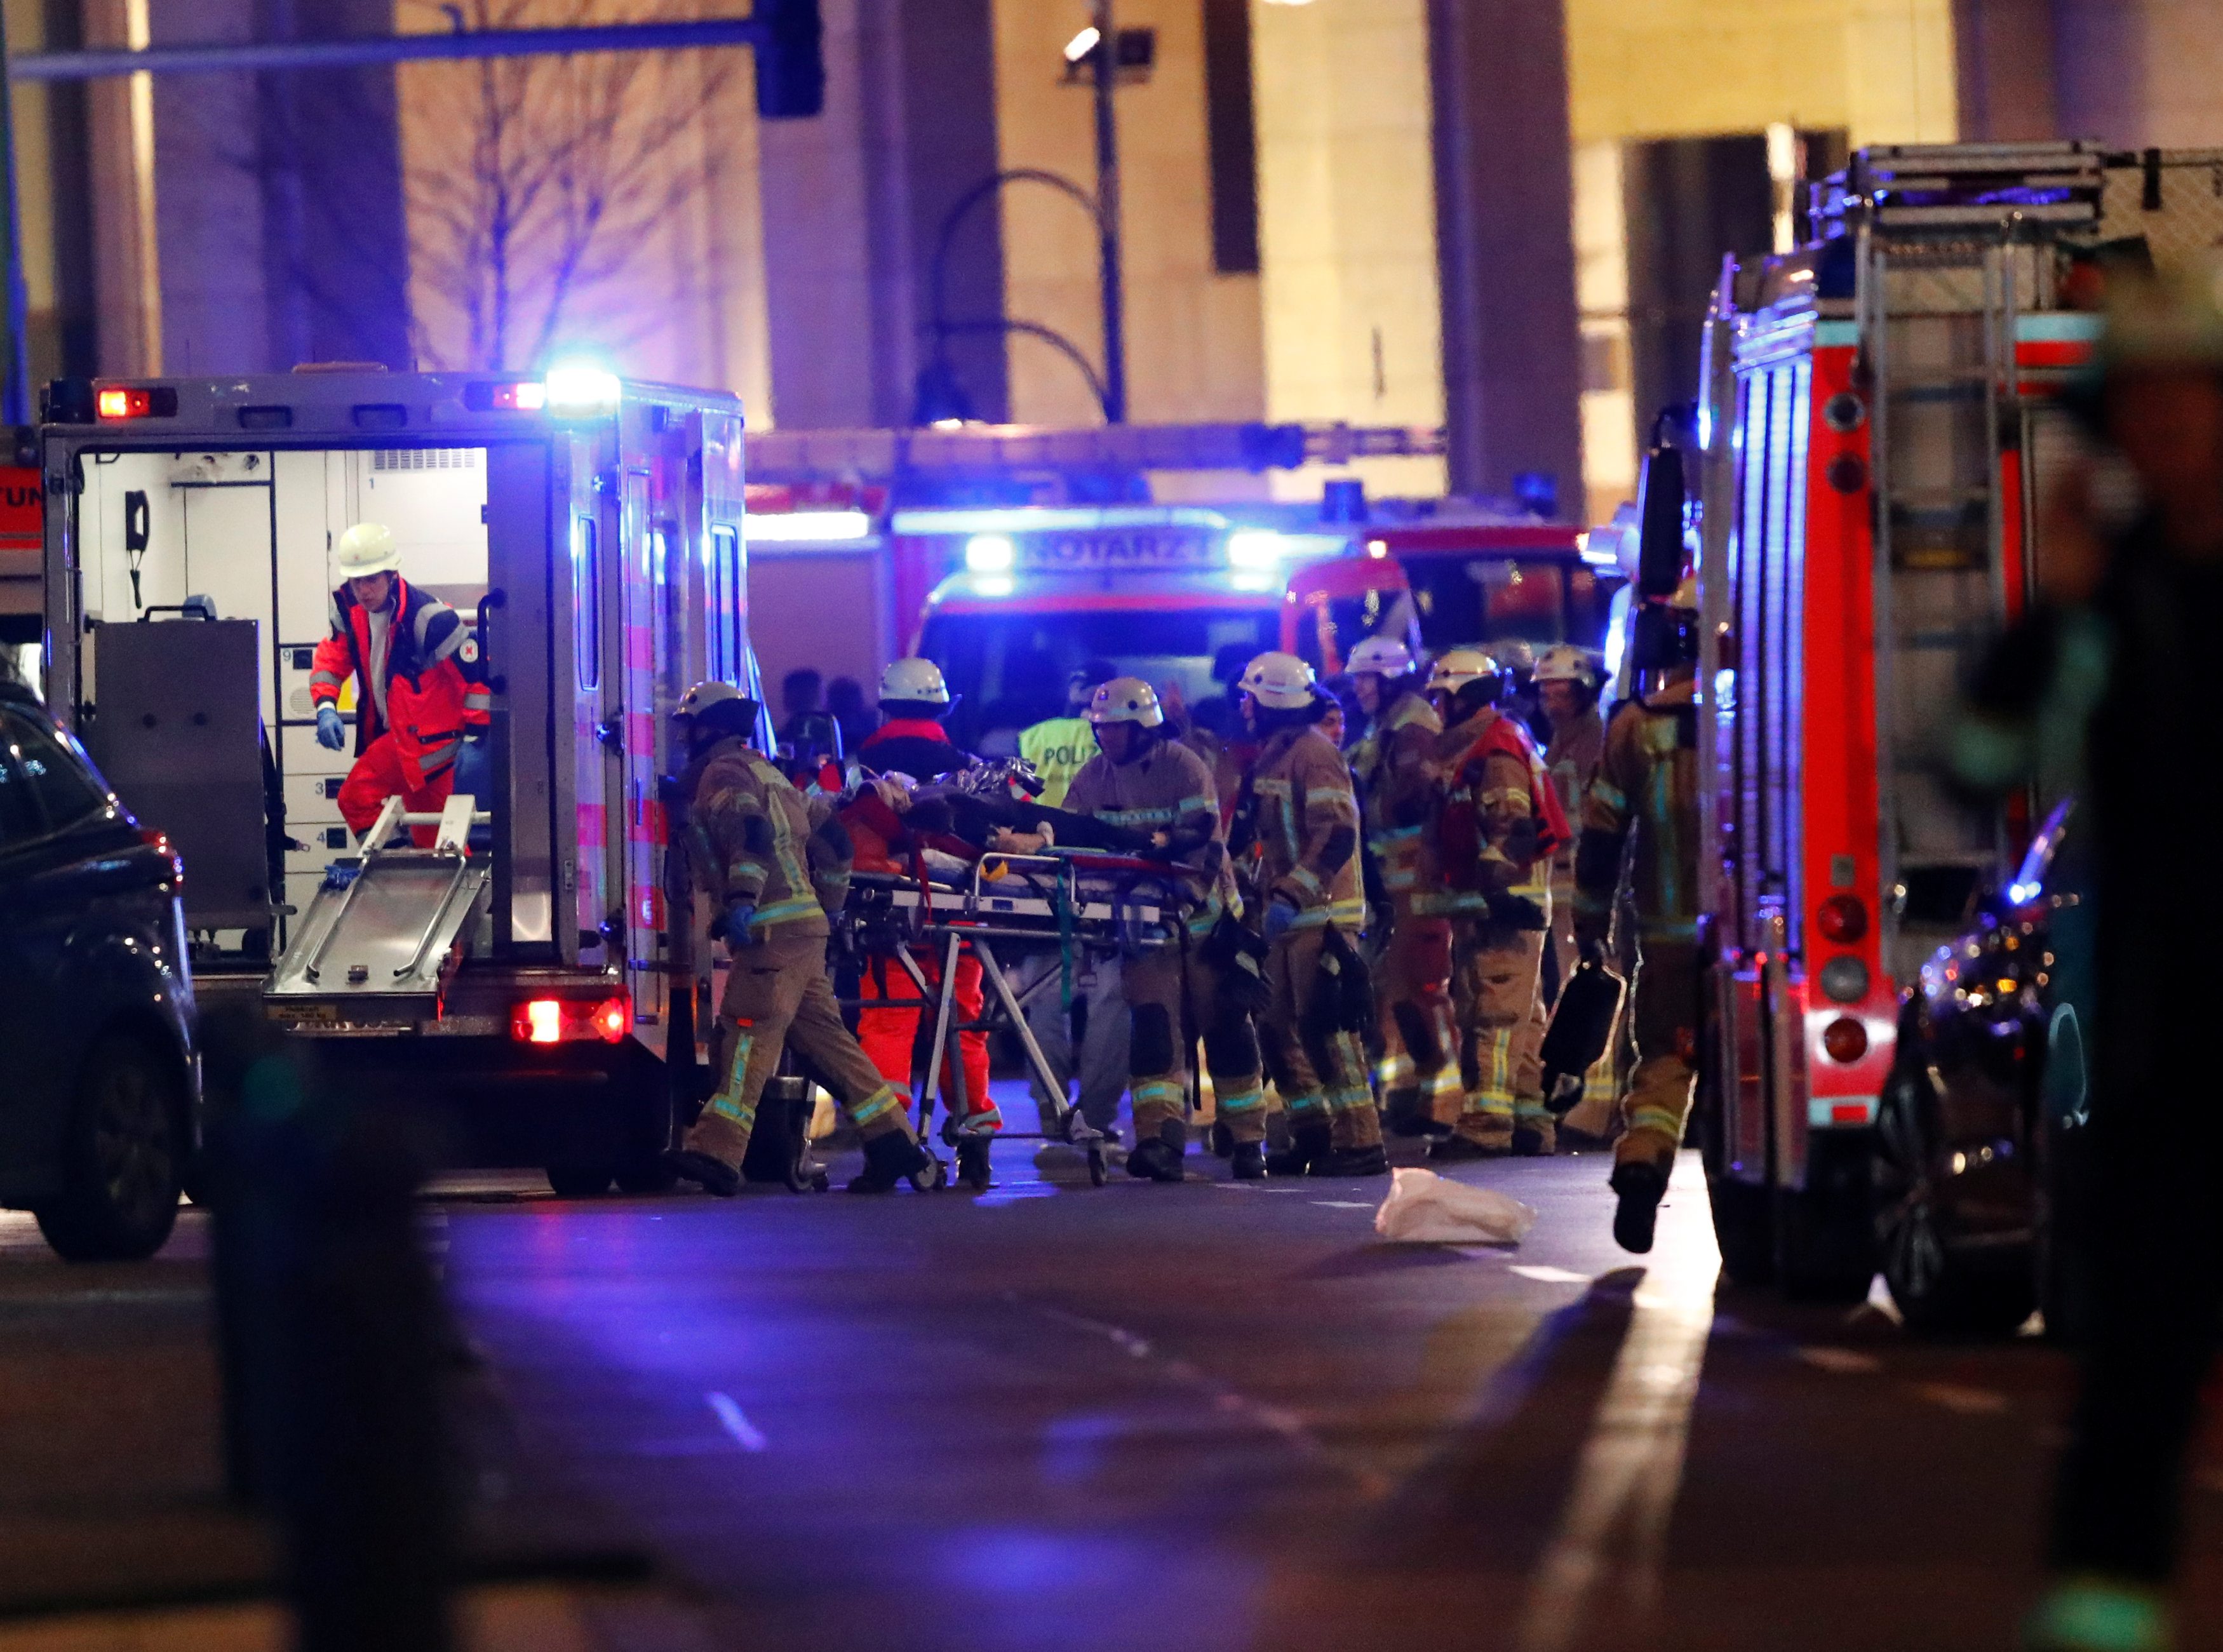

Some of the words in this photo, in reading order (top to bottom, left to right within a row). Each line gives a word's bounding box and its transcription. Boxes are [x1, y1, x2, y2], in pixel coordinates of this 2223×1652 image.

[368, 477, 375, 489] 1
[0, 487, 42, 507] UN
[283, 649, 292, 662] 9
[315, 782, 324, 795] 3
[316, 831, 326, 843] 4
